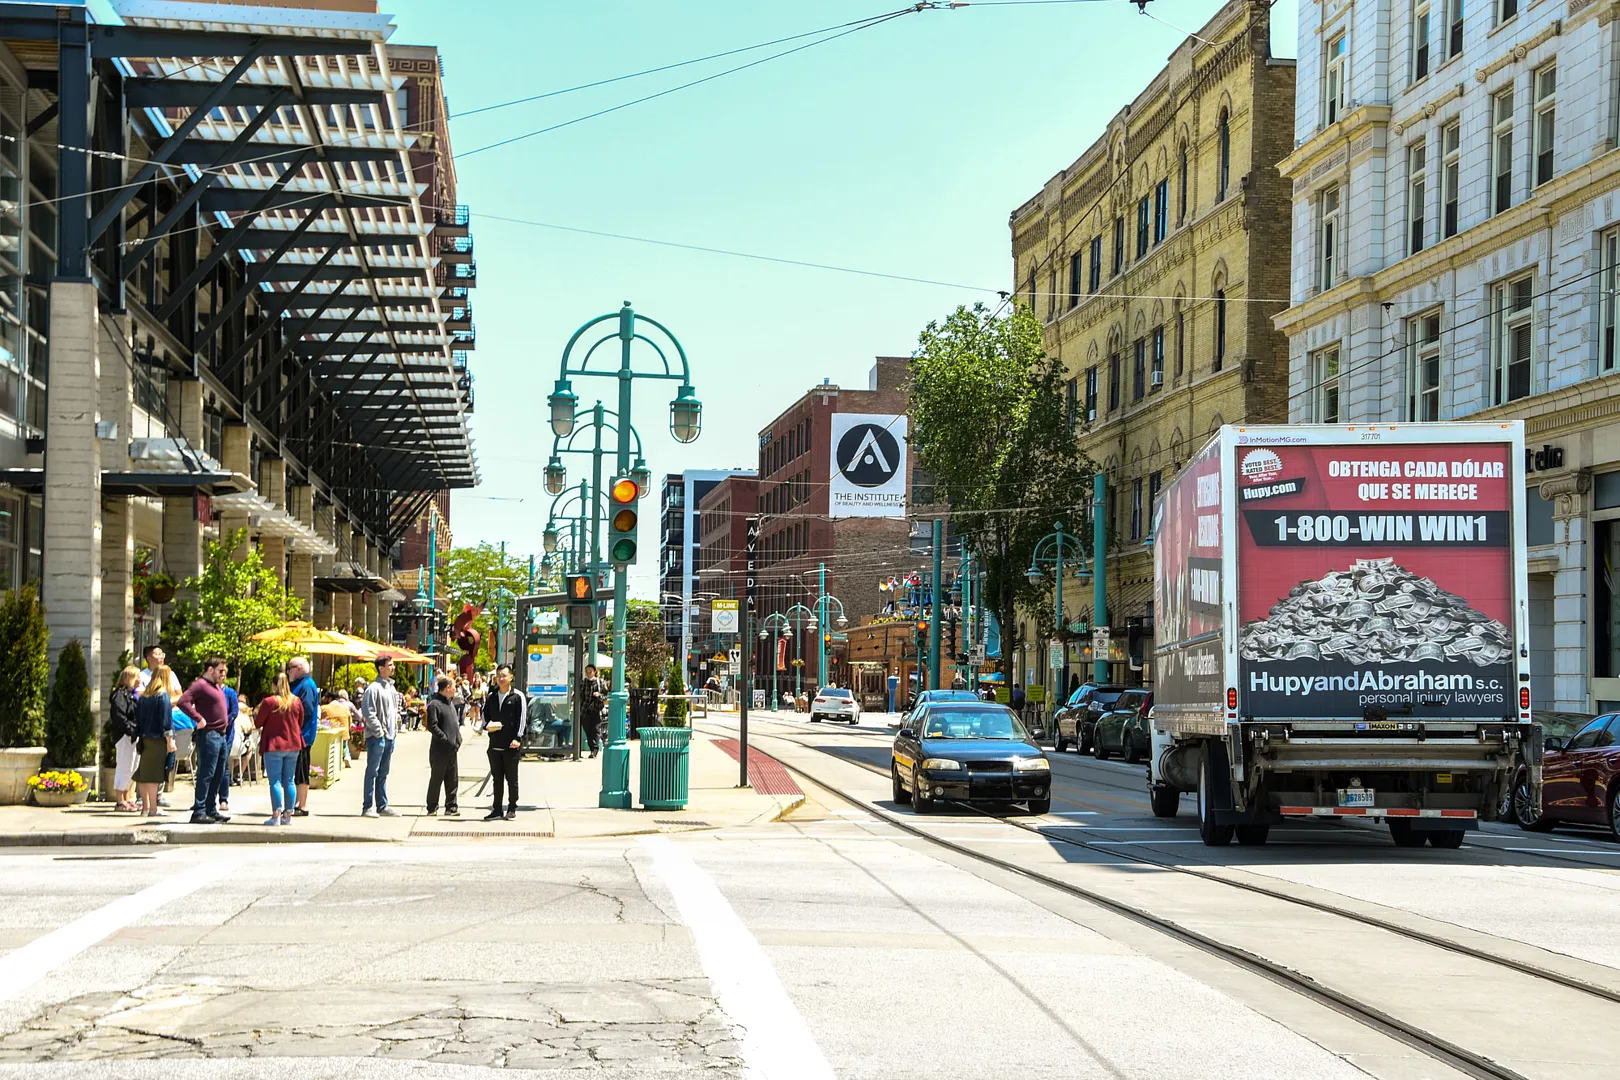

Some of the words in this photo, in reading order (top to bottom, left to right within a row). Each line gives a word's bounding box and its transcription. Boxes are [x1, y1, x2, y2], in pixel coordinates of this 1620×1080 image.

[1329, 461, 1401, 477] OBTENGA
[1404, 461, 1448, 478] CADA
[1451, 459, 1504, 478] DÓLAR
[834, 492, 852, 501] THE
[854, 492, 900, 502] INSTITUTE
[1243, 482, 1296, 499] Hupy.com
[1358, 483, 1389, 501] QUE
[1392, 483, 1412, 500] SE
[1414, 484, 1478, 500] MERECE
[1274, 515, 1412, 541] 1-800-WIN
[1418, 515, 1487, 541] WIN1
[747, 526, 755, 604] AVEDA
[1250, 670, 1473, 695] HupyandAbraham
[1358, 691, 1413, 705] personal
[1454, 691, 1504, 705] lawyers
